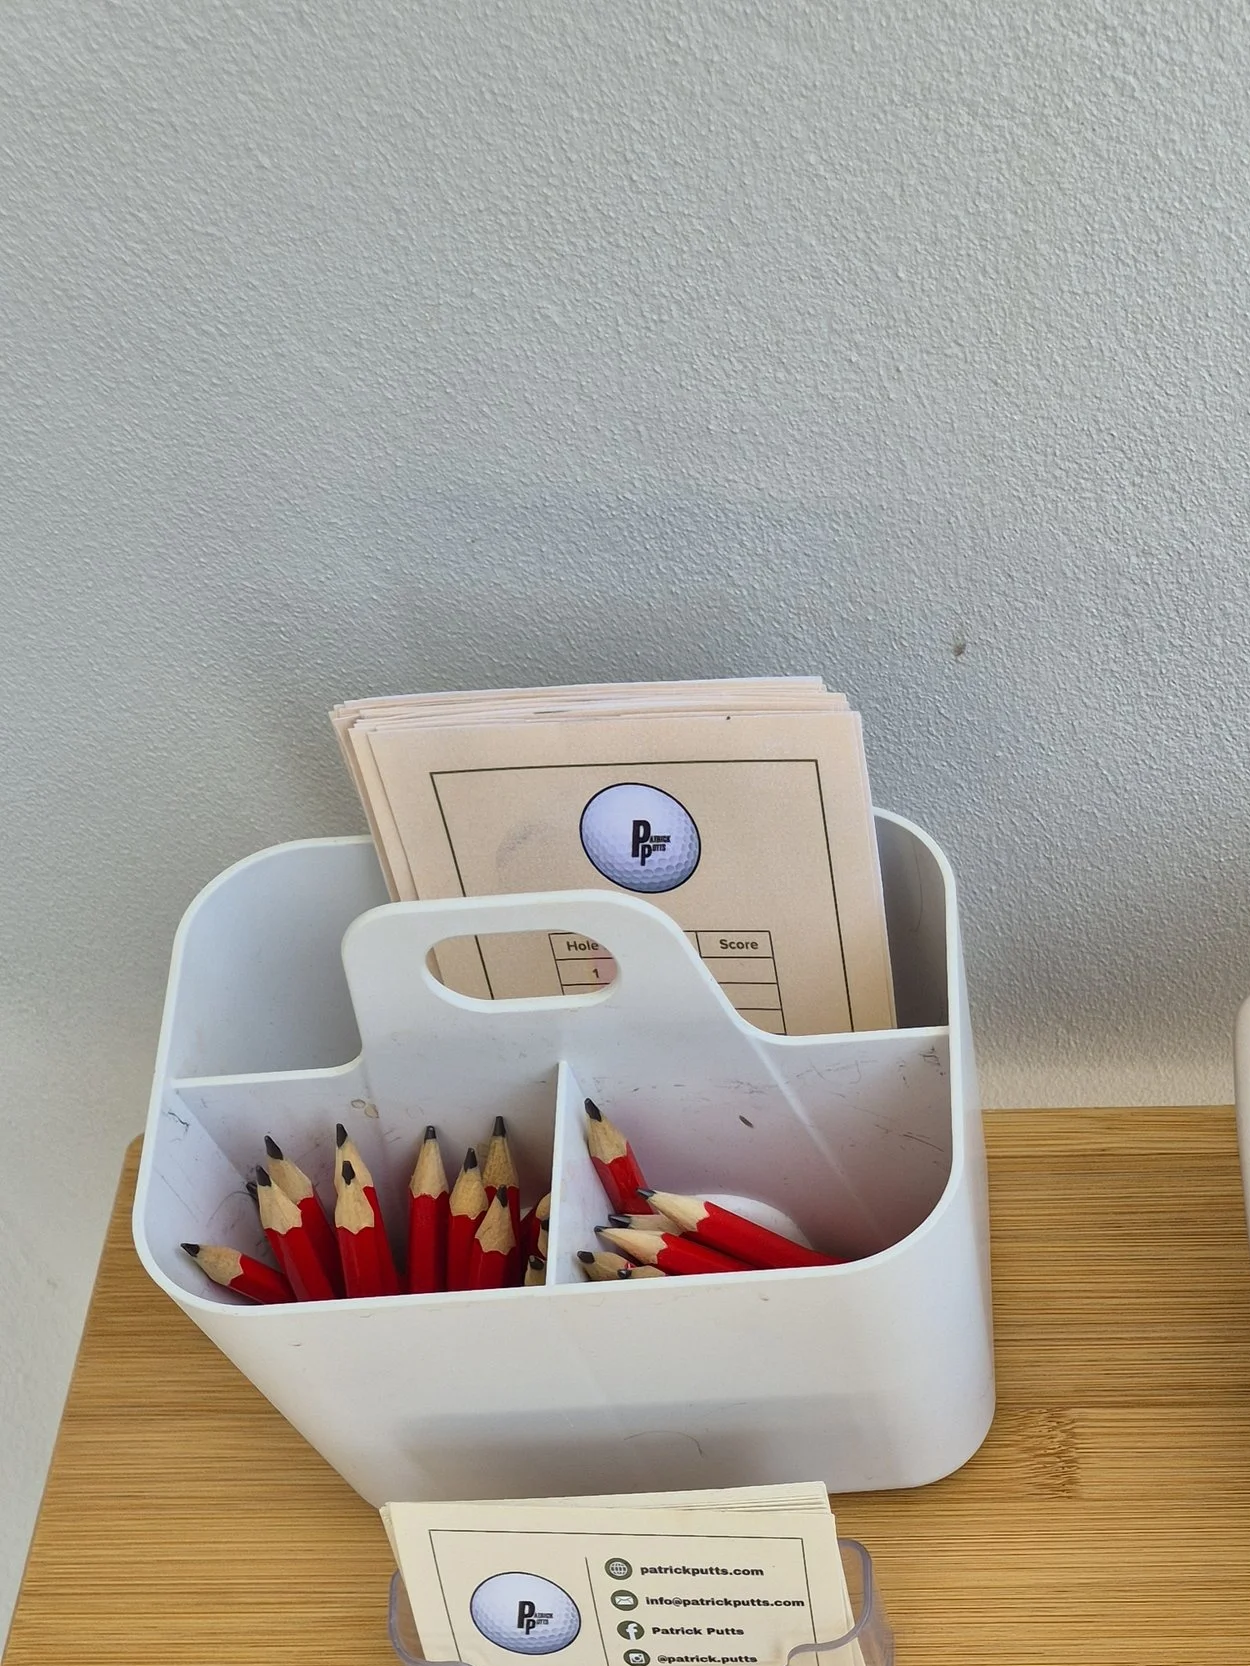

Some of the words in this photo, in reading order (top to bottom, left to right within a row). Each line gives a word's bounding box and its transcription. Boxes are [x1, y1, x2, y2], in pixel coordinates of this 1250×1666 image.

[566, 940, 599, 952] Hole
[719, 938, 759, 950] Score
[592, 968, 600, 979] 1
[640, 1565, 765, 1577] patrickputts.com
[645, 1596, 805, 1609] info@patrickputts.com
[651, 1626, 703, 1636] Patrick
[706, 1626, 745, 1636] Putts
[657, 1654, 758, 1665] @patrick.putts
